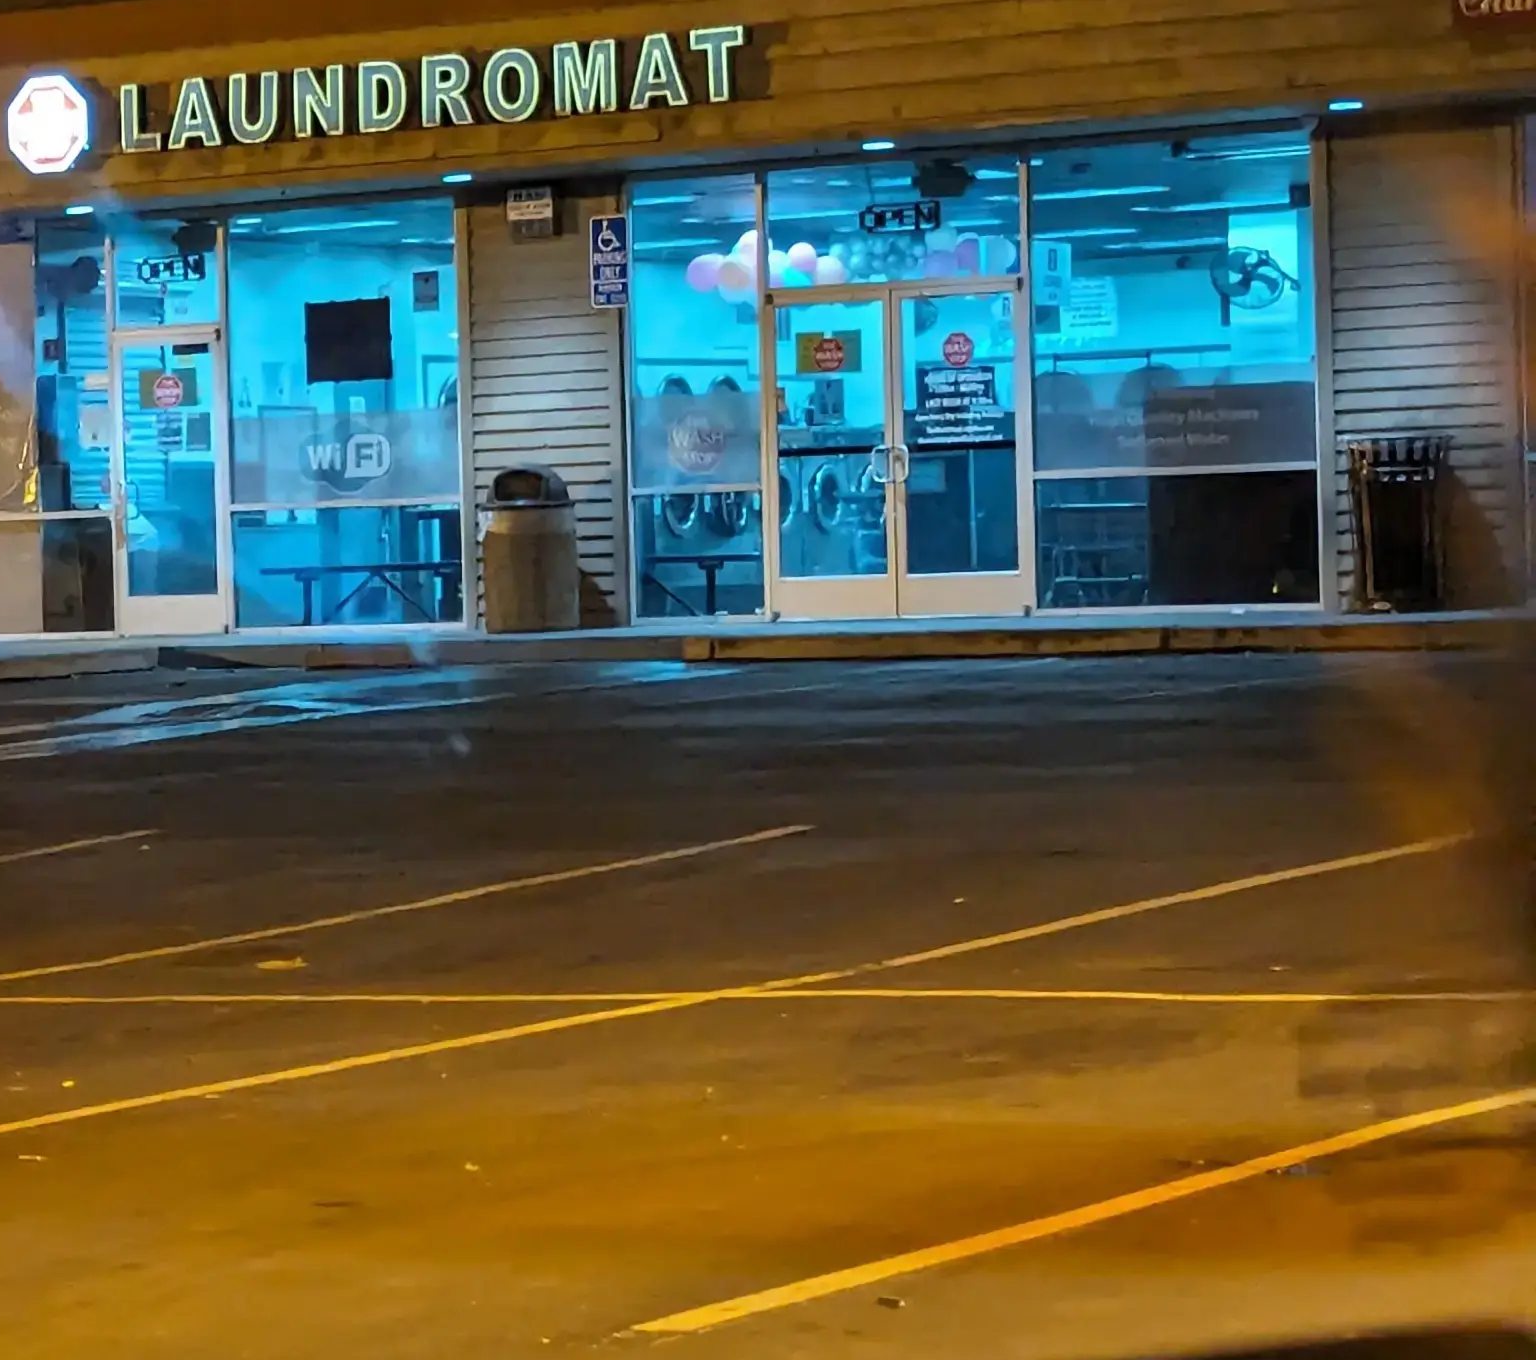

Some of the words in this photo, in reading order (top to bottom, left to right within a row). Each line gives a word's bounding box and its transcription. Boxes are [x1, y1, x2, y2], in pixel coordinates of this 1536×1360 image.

[120, 25, 744, 153] LAUNDROMAT
[859, 201, 940, 233] OPEN
[137, 252, 206, 284] OPEN
